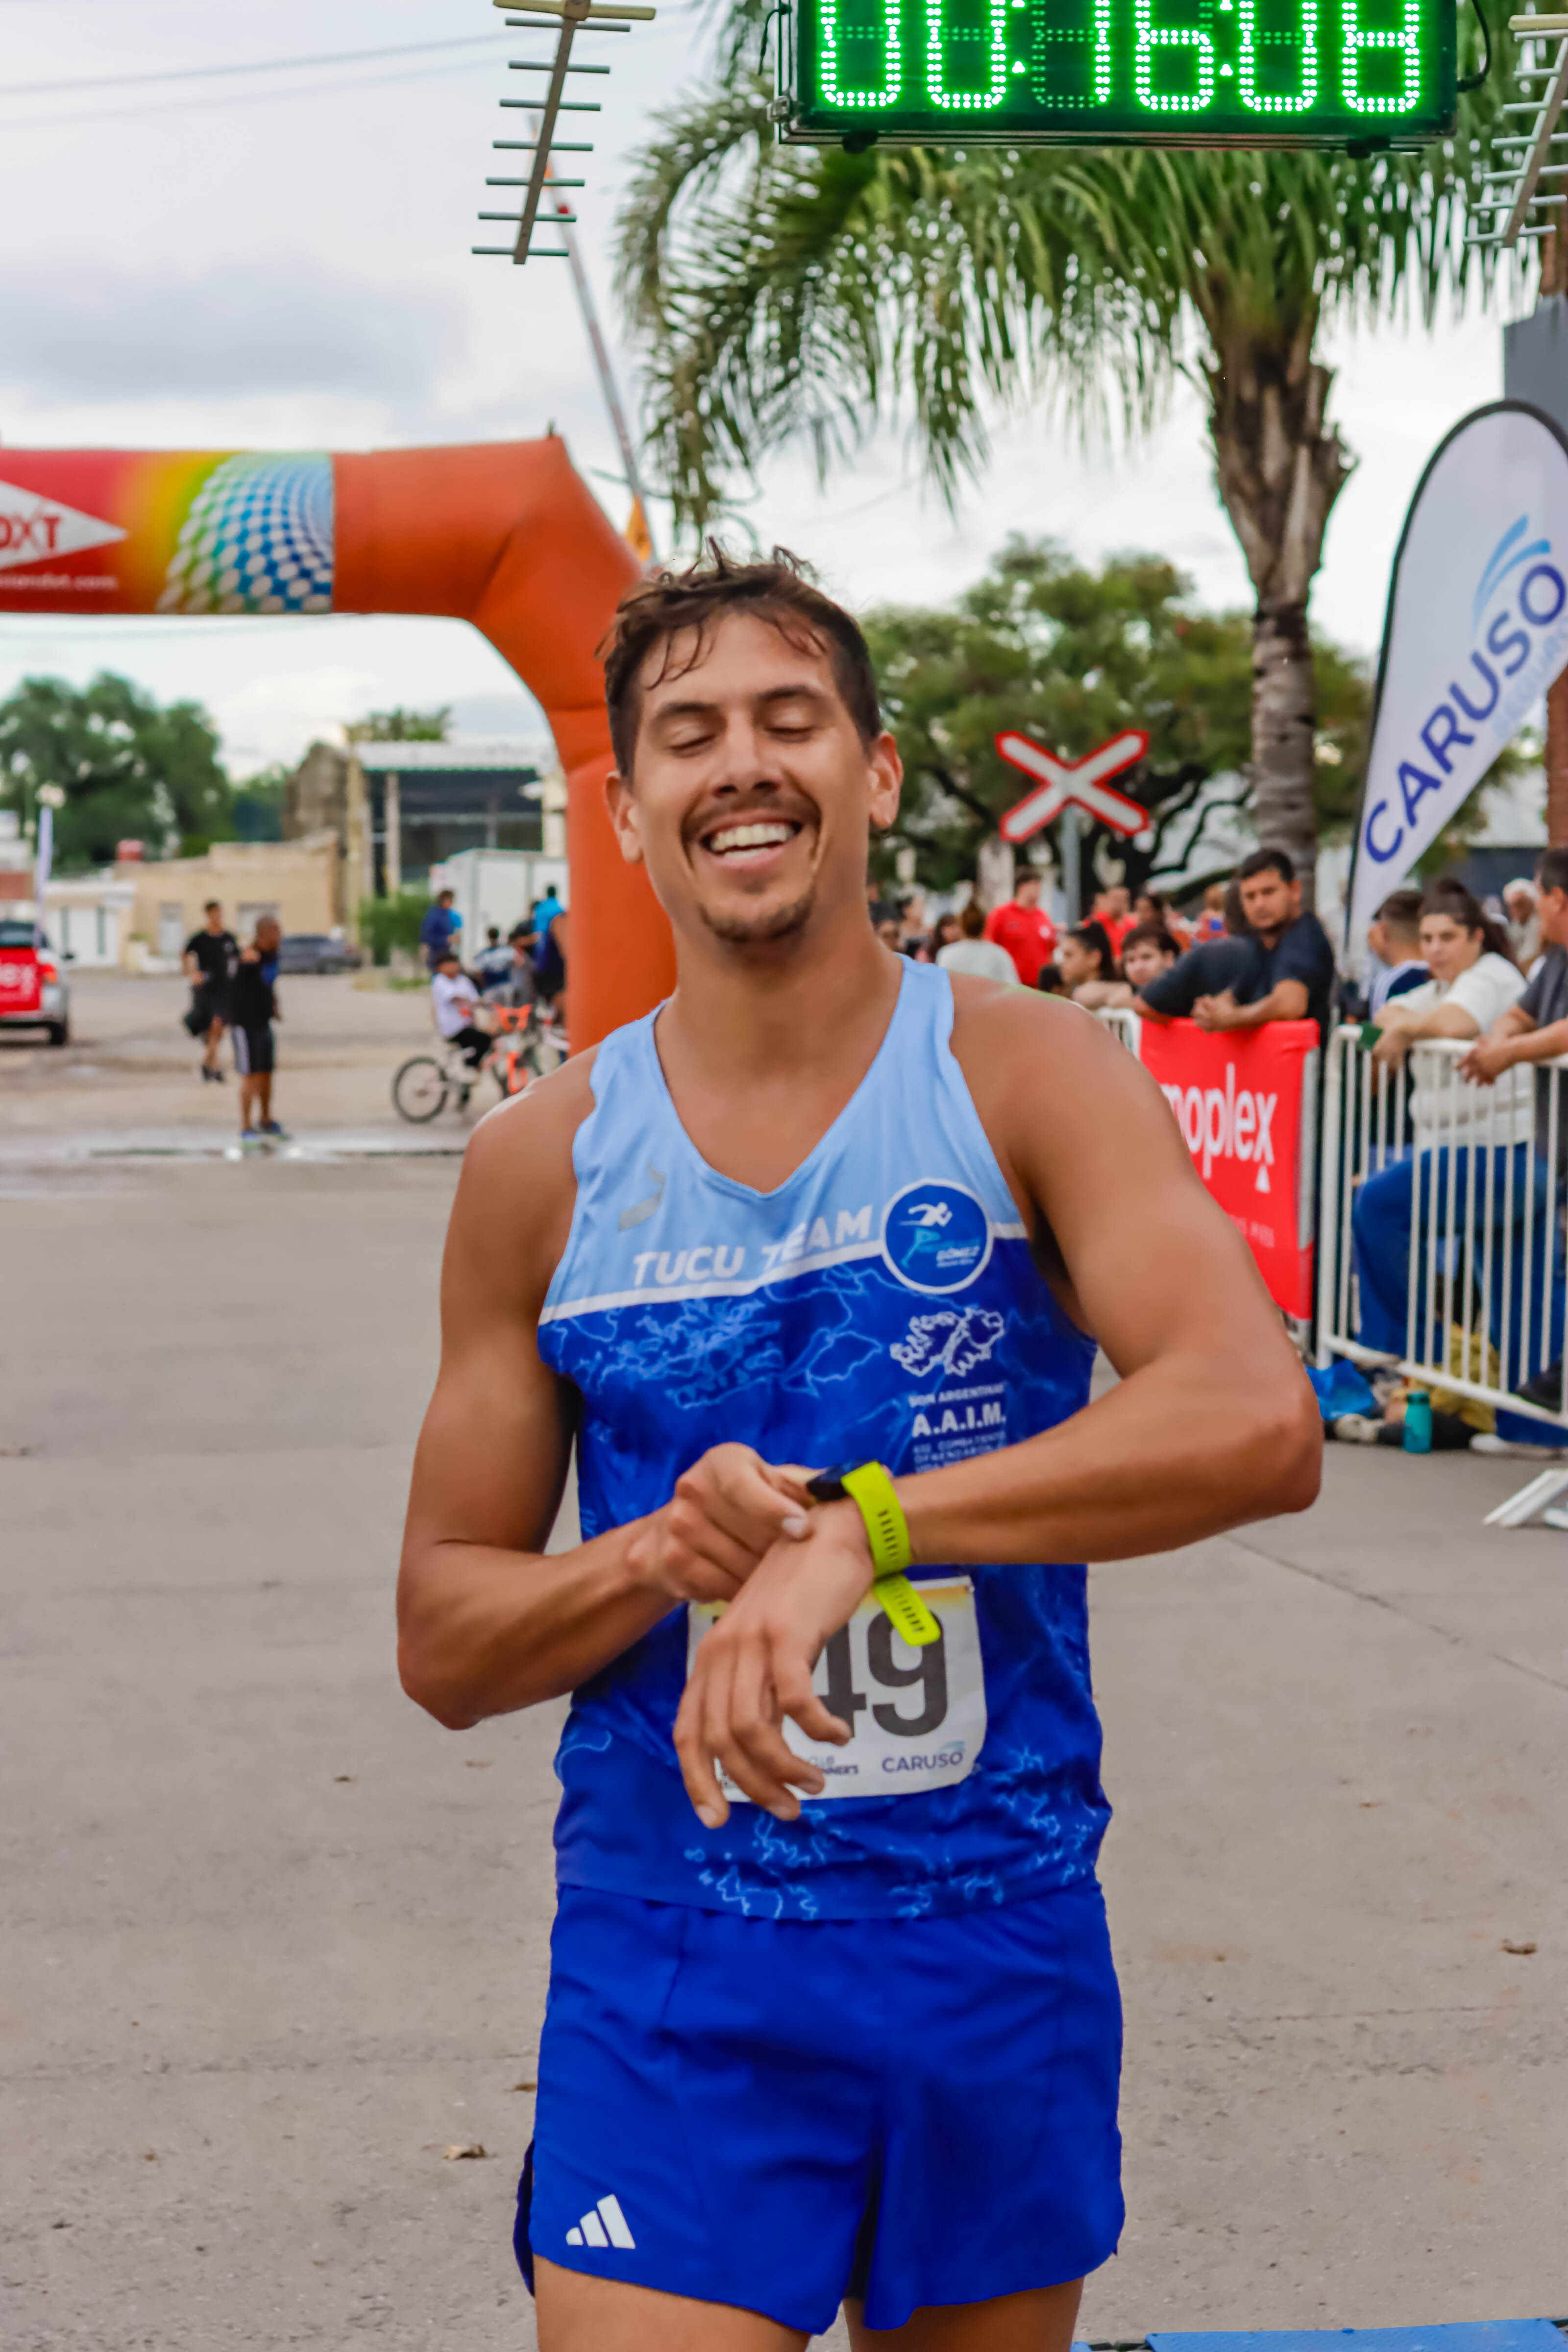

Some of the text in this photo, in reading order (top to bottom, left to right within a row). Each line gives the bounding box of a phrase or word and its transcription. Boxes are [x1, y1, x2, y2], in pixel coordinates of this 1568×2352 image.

[1366, 563, 1566, 863] CARUSO
[633, 1204, 873, 1287] TUCU TEAM
[912, 1401, 1006, 1439] A.A.I.M.
[882, 1751, 963, 1773] CARUSO
